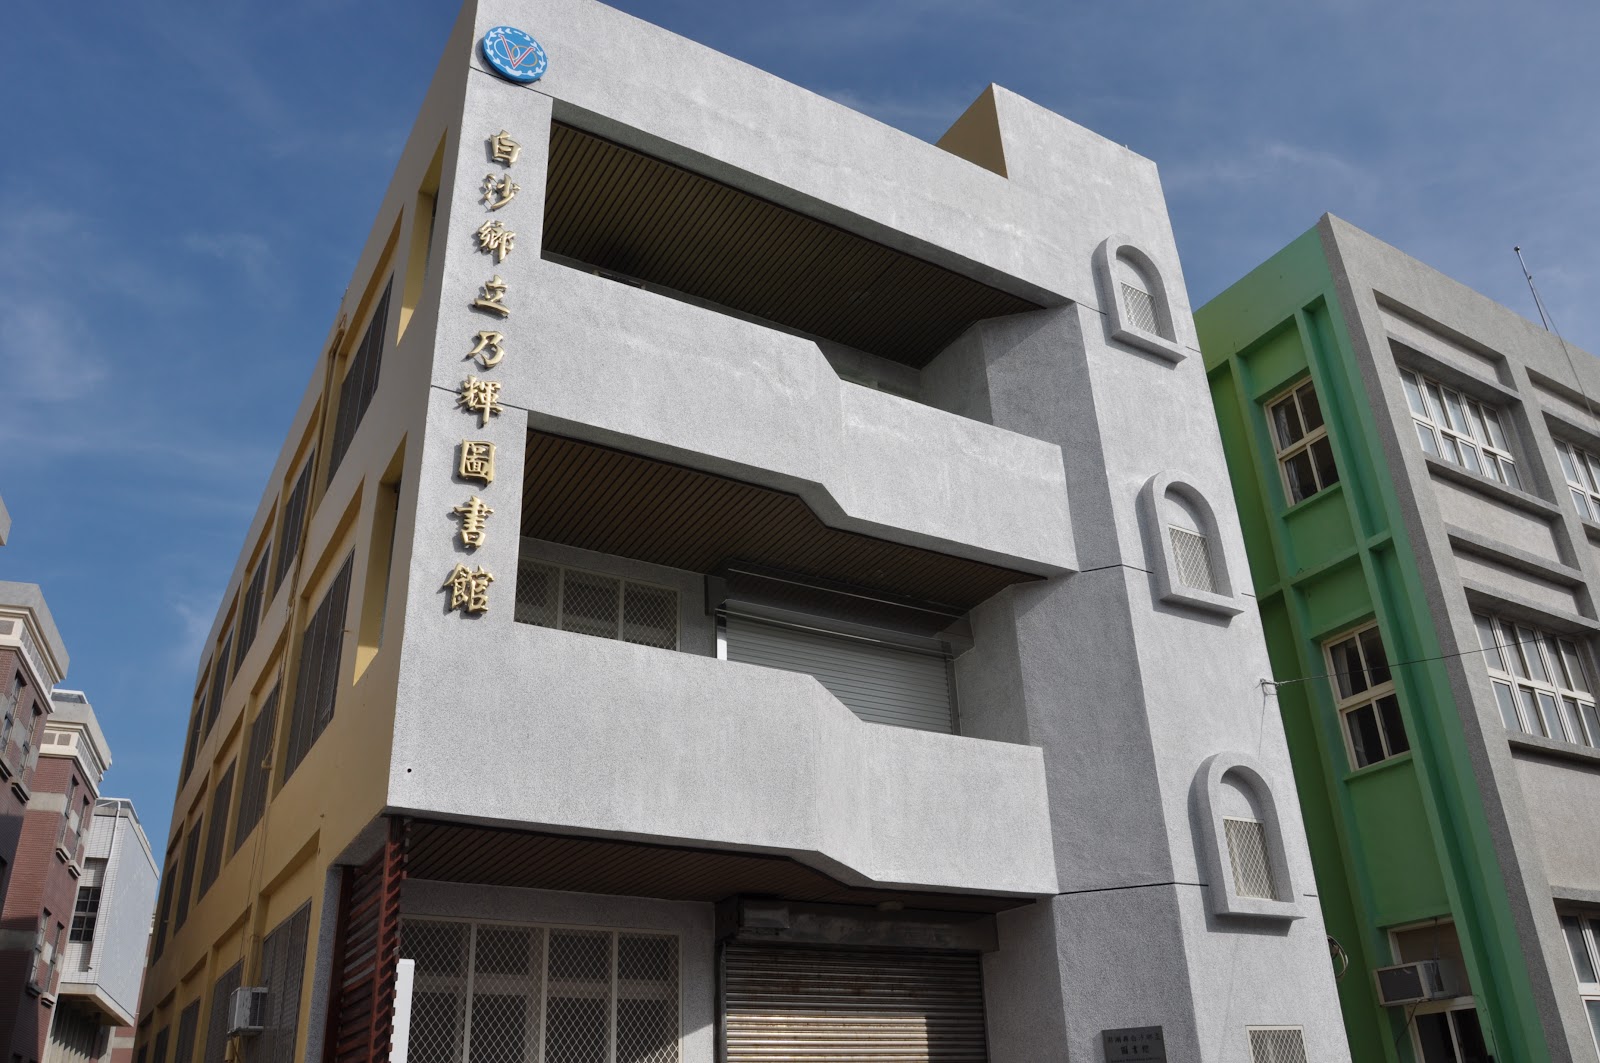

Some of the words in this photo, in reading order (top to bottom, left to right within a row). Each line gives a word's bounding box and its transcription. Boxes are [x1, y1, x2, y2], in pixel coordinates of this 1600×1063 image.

[443, 129, 521, 613] 白沙鄉立乃輝圖書館
